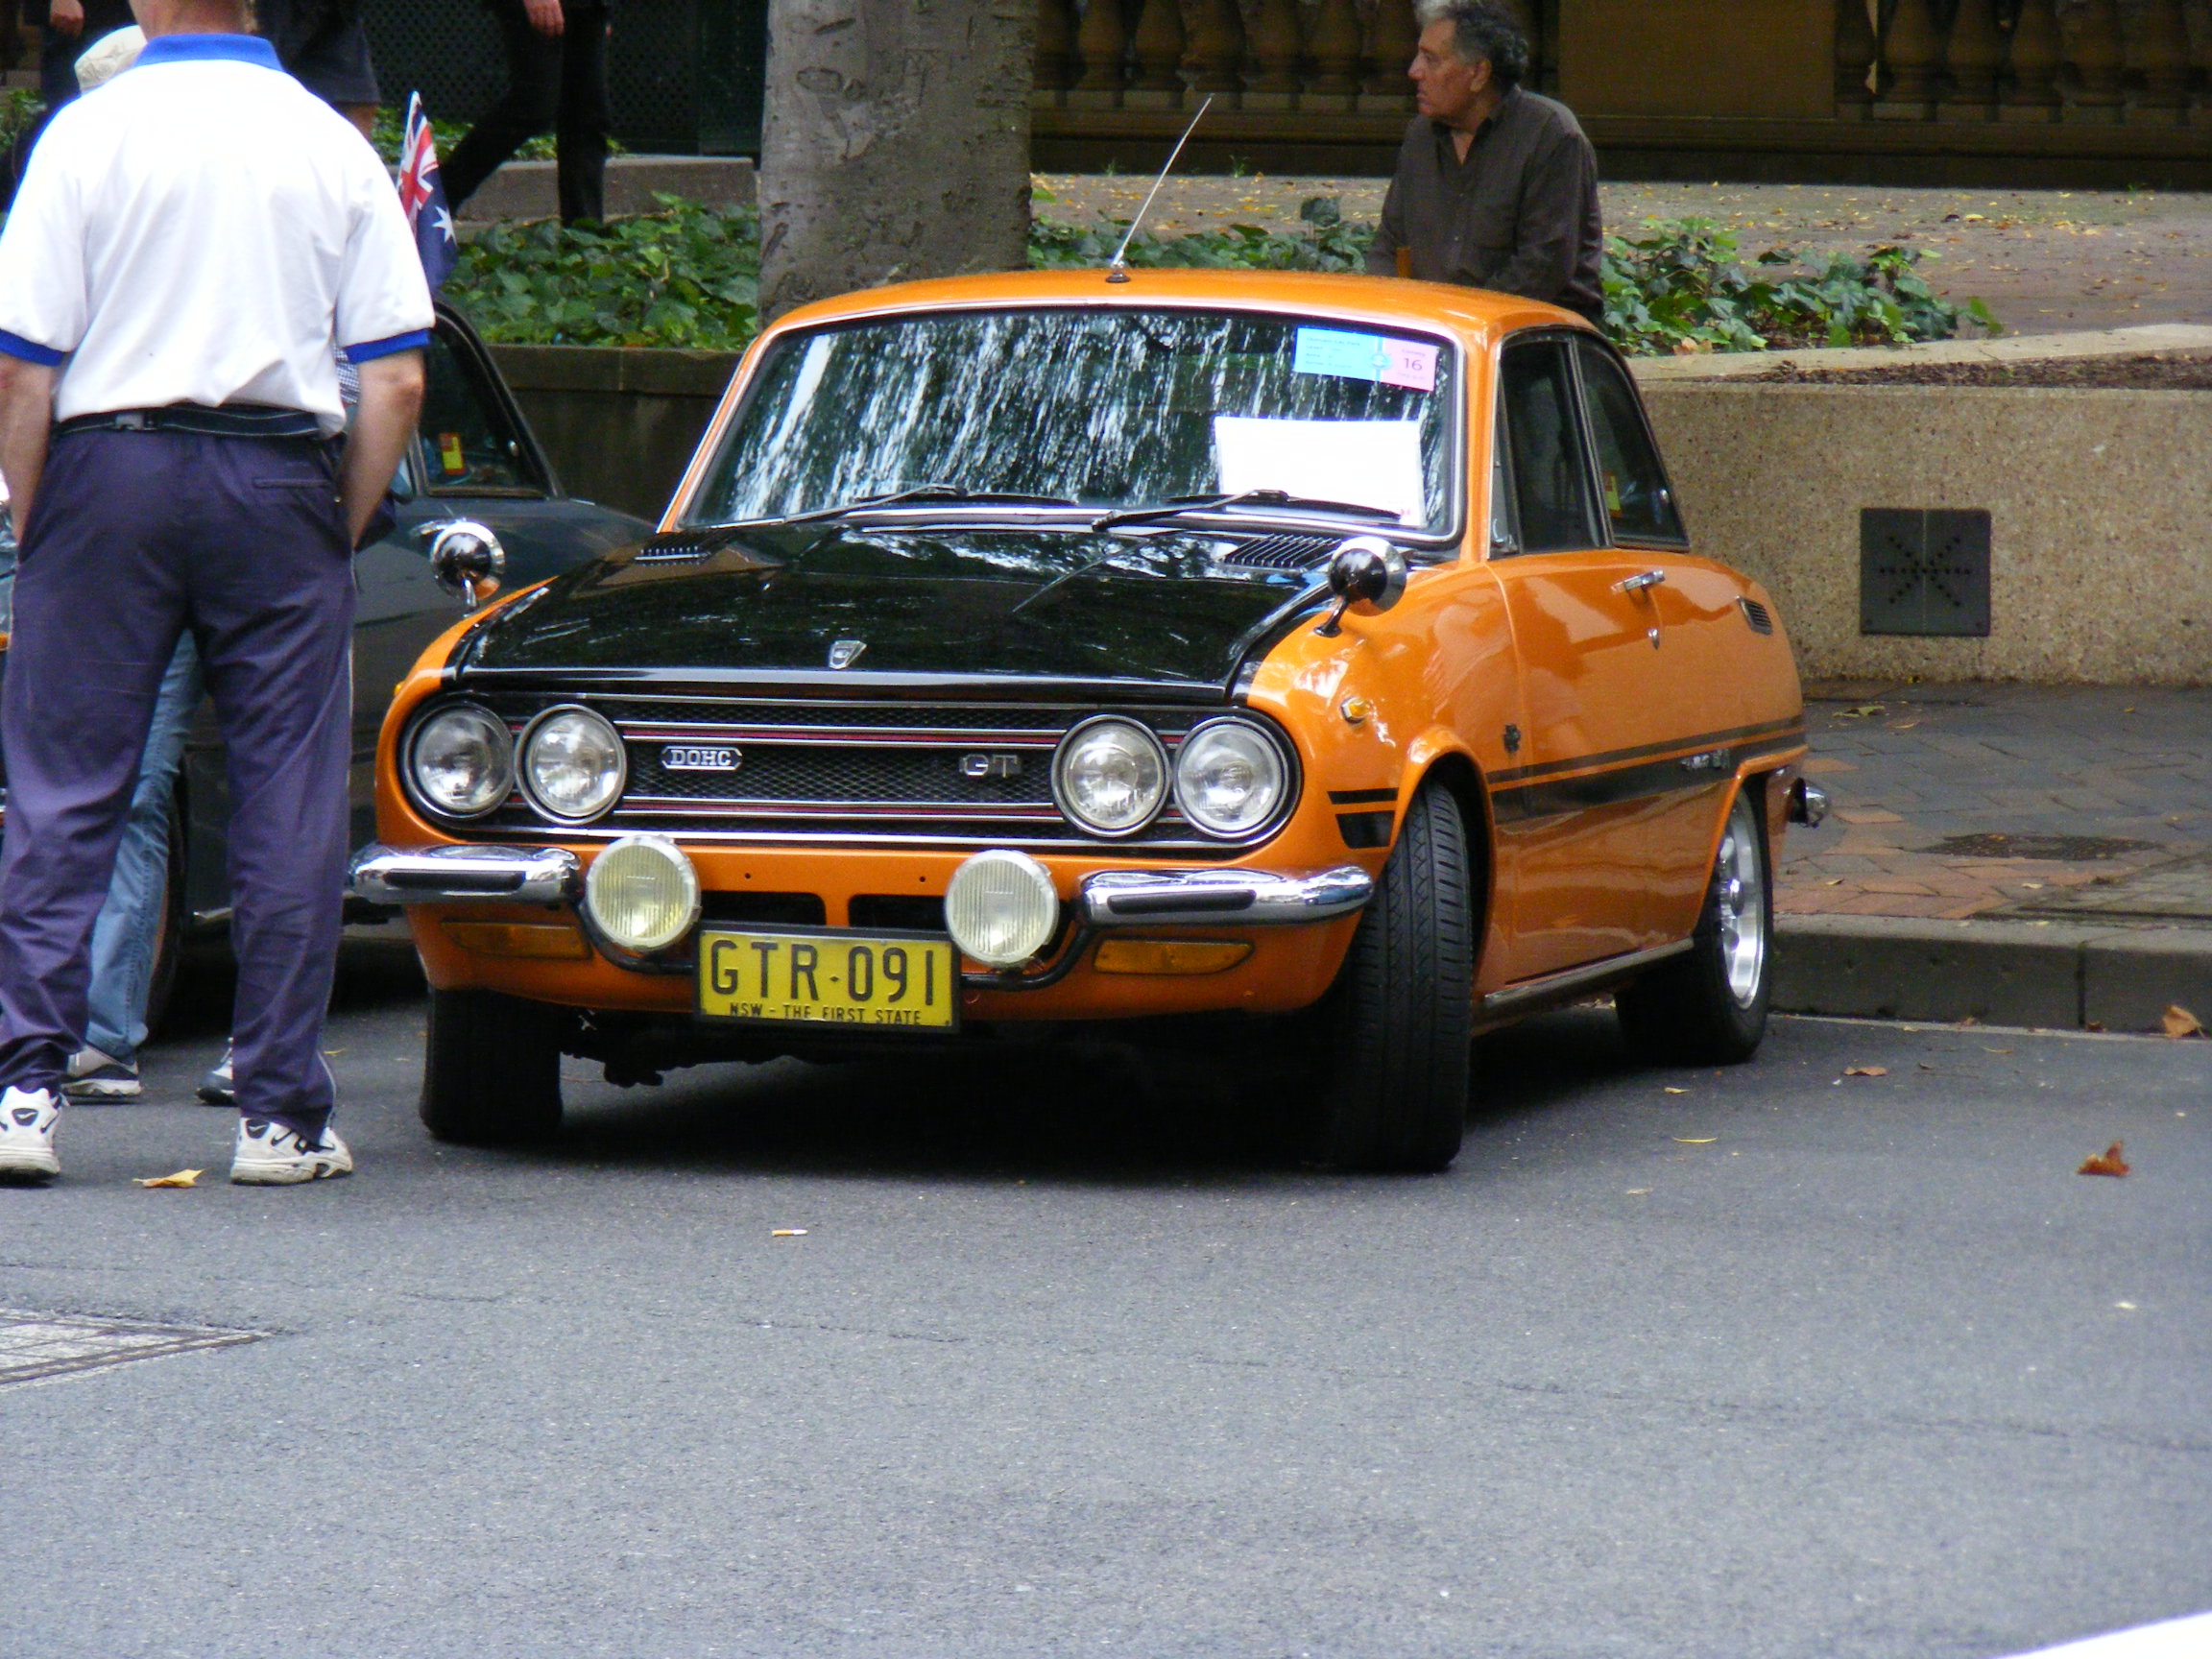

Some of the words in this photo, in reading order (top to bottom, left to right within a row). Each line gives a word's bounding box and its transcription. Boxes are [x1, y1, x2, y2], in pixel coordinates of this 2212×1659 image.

[1404, 357, 1423, 372] 16
[670, 749, 732, 766] DOHC
[963, 754, 1019, 778] GT
[730, 1002, 763, 1017] NSW
[783, 1004, 811, 1020] THE
[822, 1006, 866, 1022] FIRST
[876, 1009, 922, 1025] STATE
